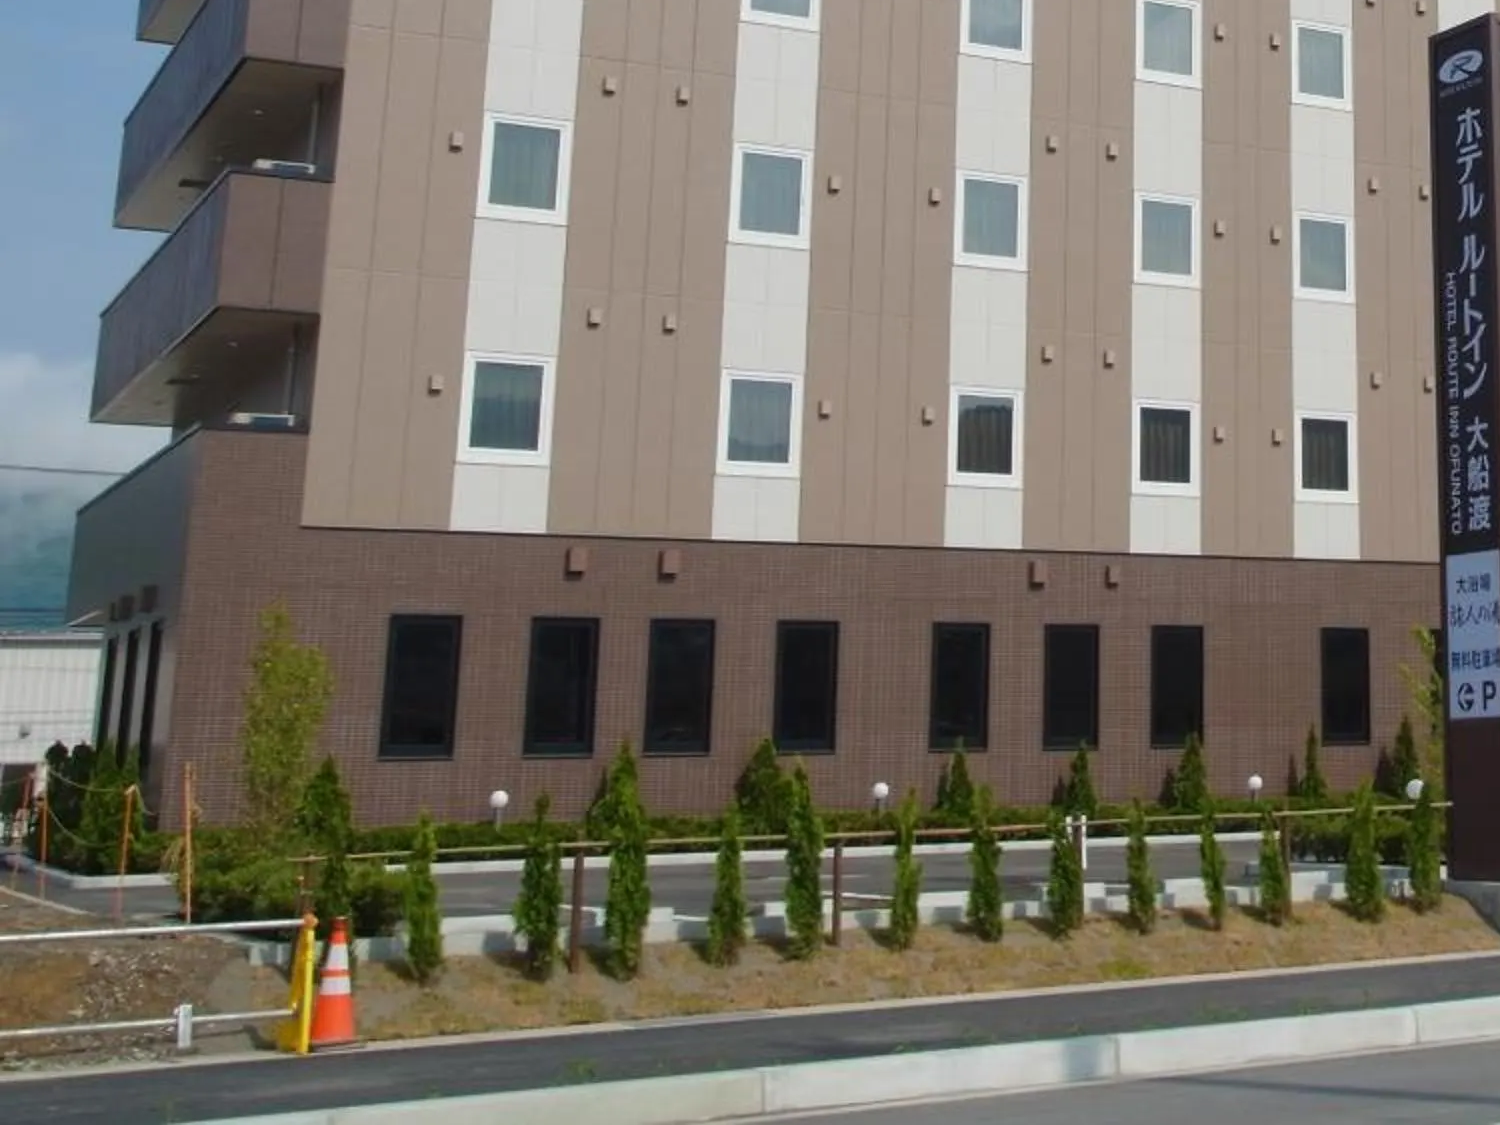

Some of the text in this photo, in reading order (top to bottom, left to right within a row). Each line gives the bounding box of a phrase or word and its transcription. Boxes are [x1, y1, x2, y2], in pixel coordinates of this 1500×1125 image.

[1455, 106, 1485, 223] ホテル
[1459, 233, 1488, 400] ルートイン
[1445, 272, 1462, 535] HOTEL ROUTE INN OFUNATO
[1465, 414, 1491, 532] 大船渡
